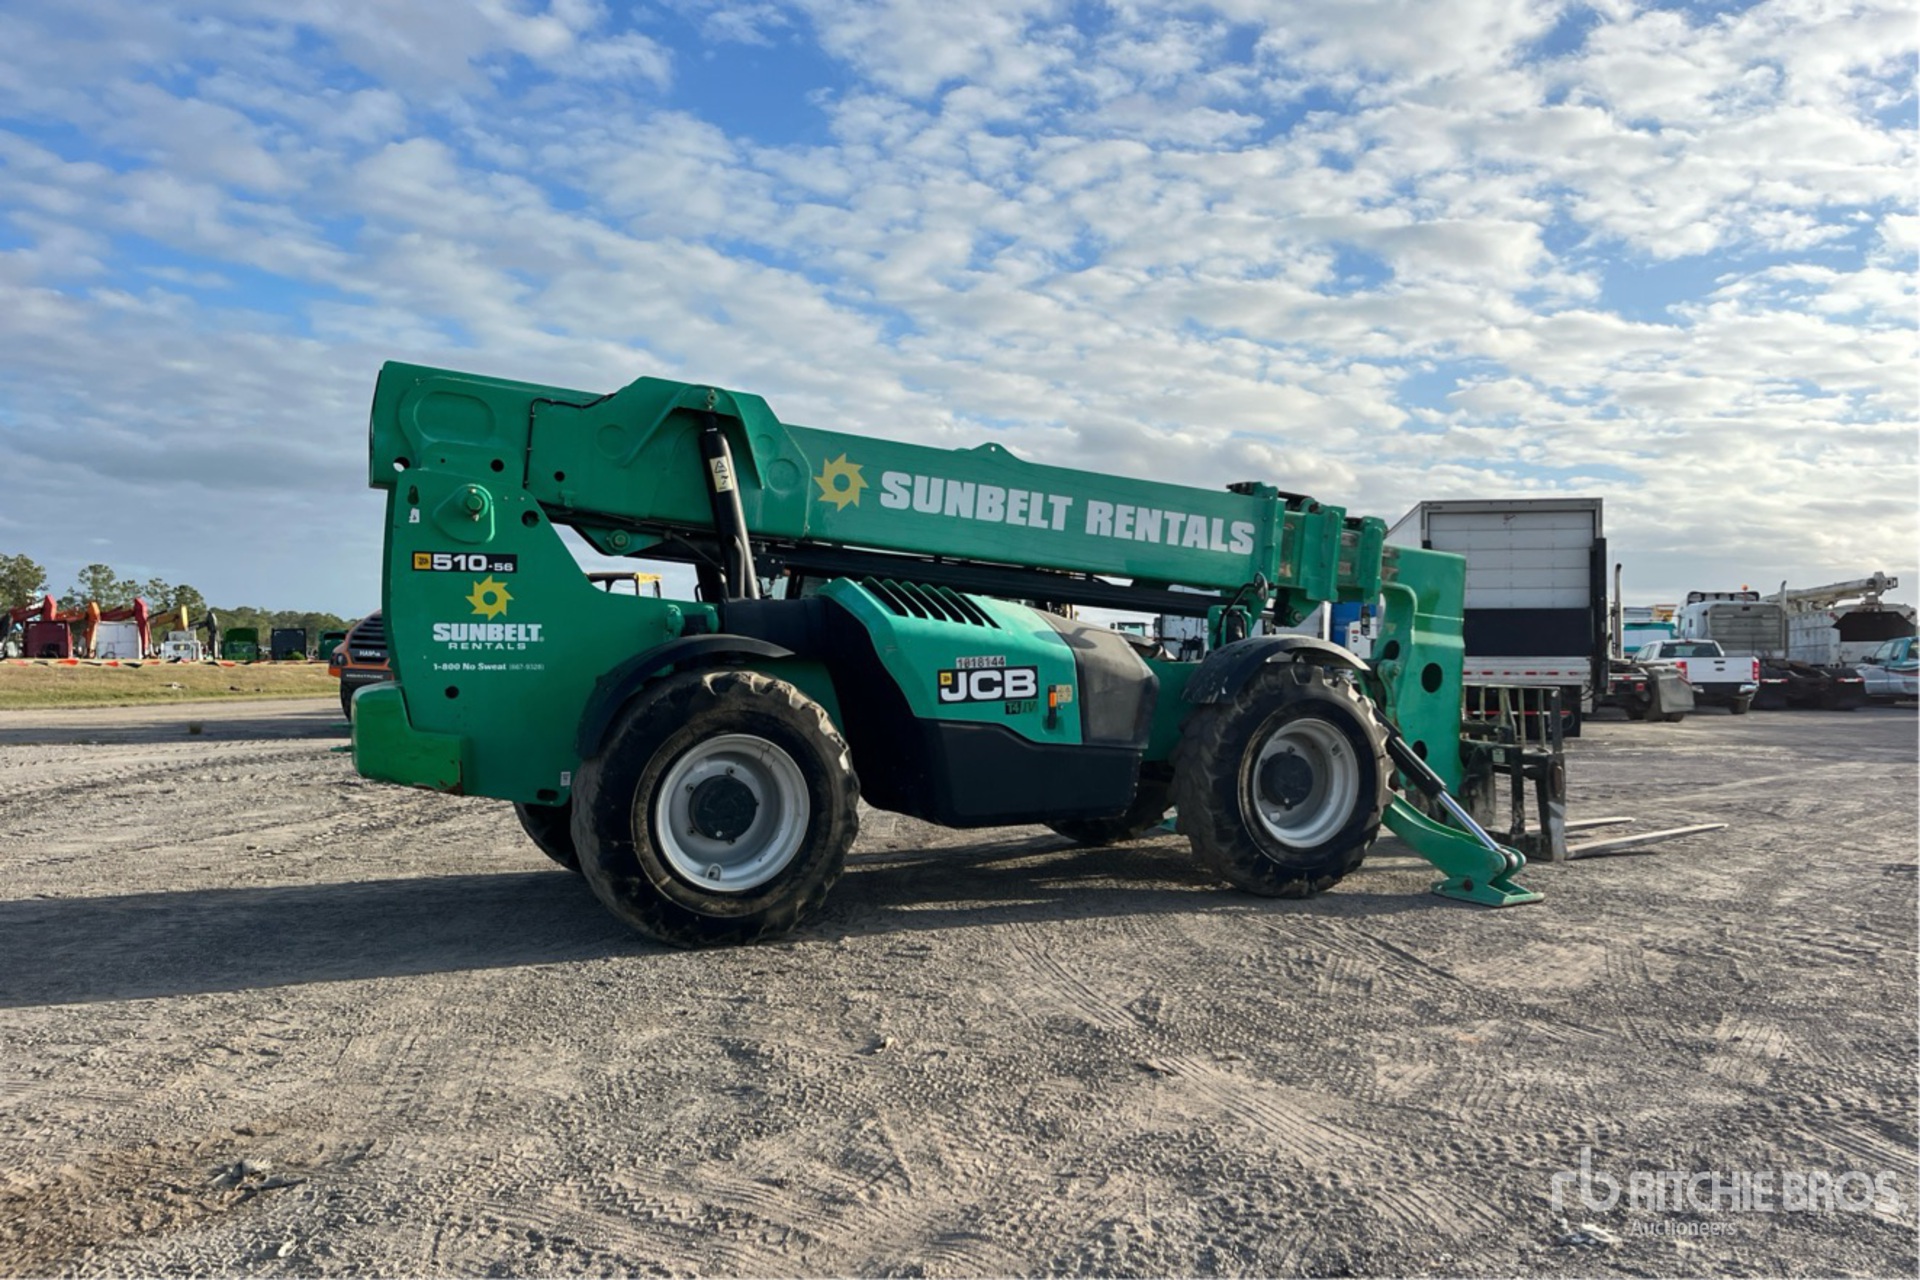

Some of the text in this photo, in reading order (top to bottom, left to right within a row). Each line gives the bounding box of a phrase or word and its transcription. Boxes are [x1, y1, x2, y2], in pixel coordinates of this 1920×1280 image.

[880, 471, 1255, 555] SUNBELT RENTALS
[433, 623, 542, 642] SUNBELT
[940, 669, 1037, 702] JCB
